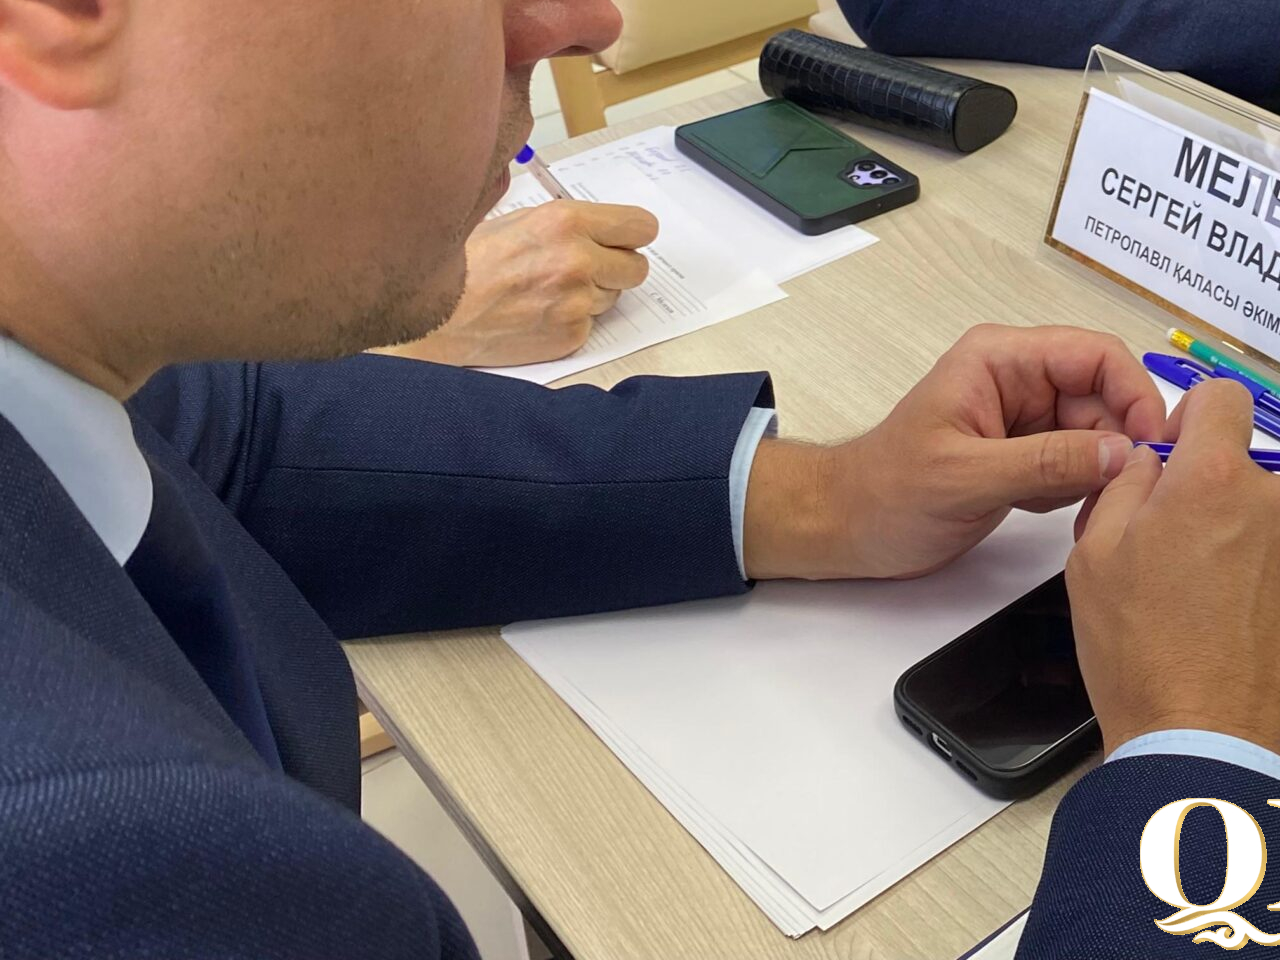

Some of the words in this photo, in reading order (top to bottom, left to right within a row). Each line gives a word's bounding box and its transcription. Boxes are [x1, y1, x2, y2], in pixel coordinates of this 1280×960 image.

[1101, 167, 1202, 240] СЕРГЕЙ
[1085, 215, 1171, 274] ПЕТРОПАВЛ
[1173, 262, 1239, 311] ҚАЛАСЫ
